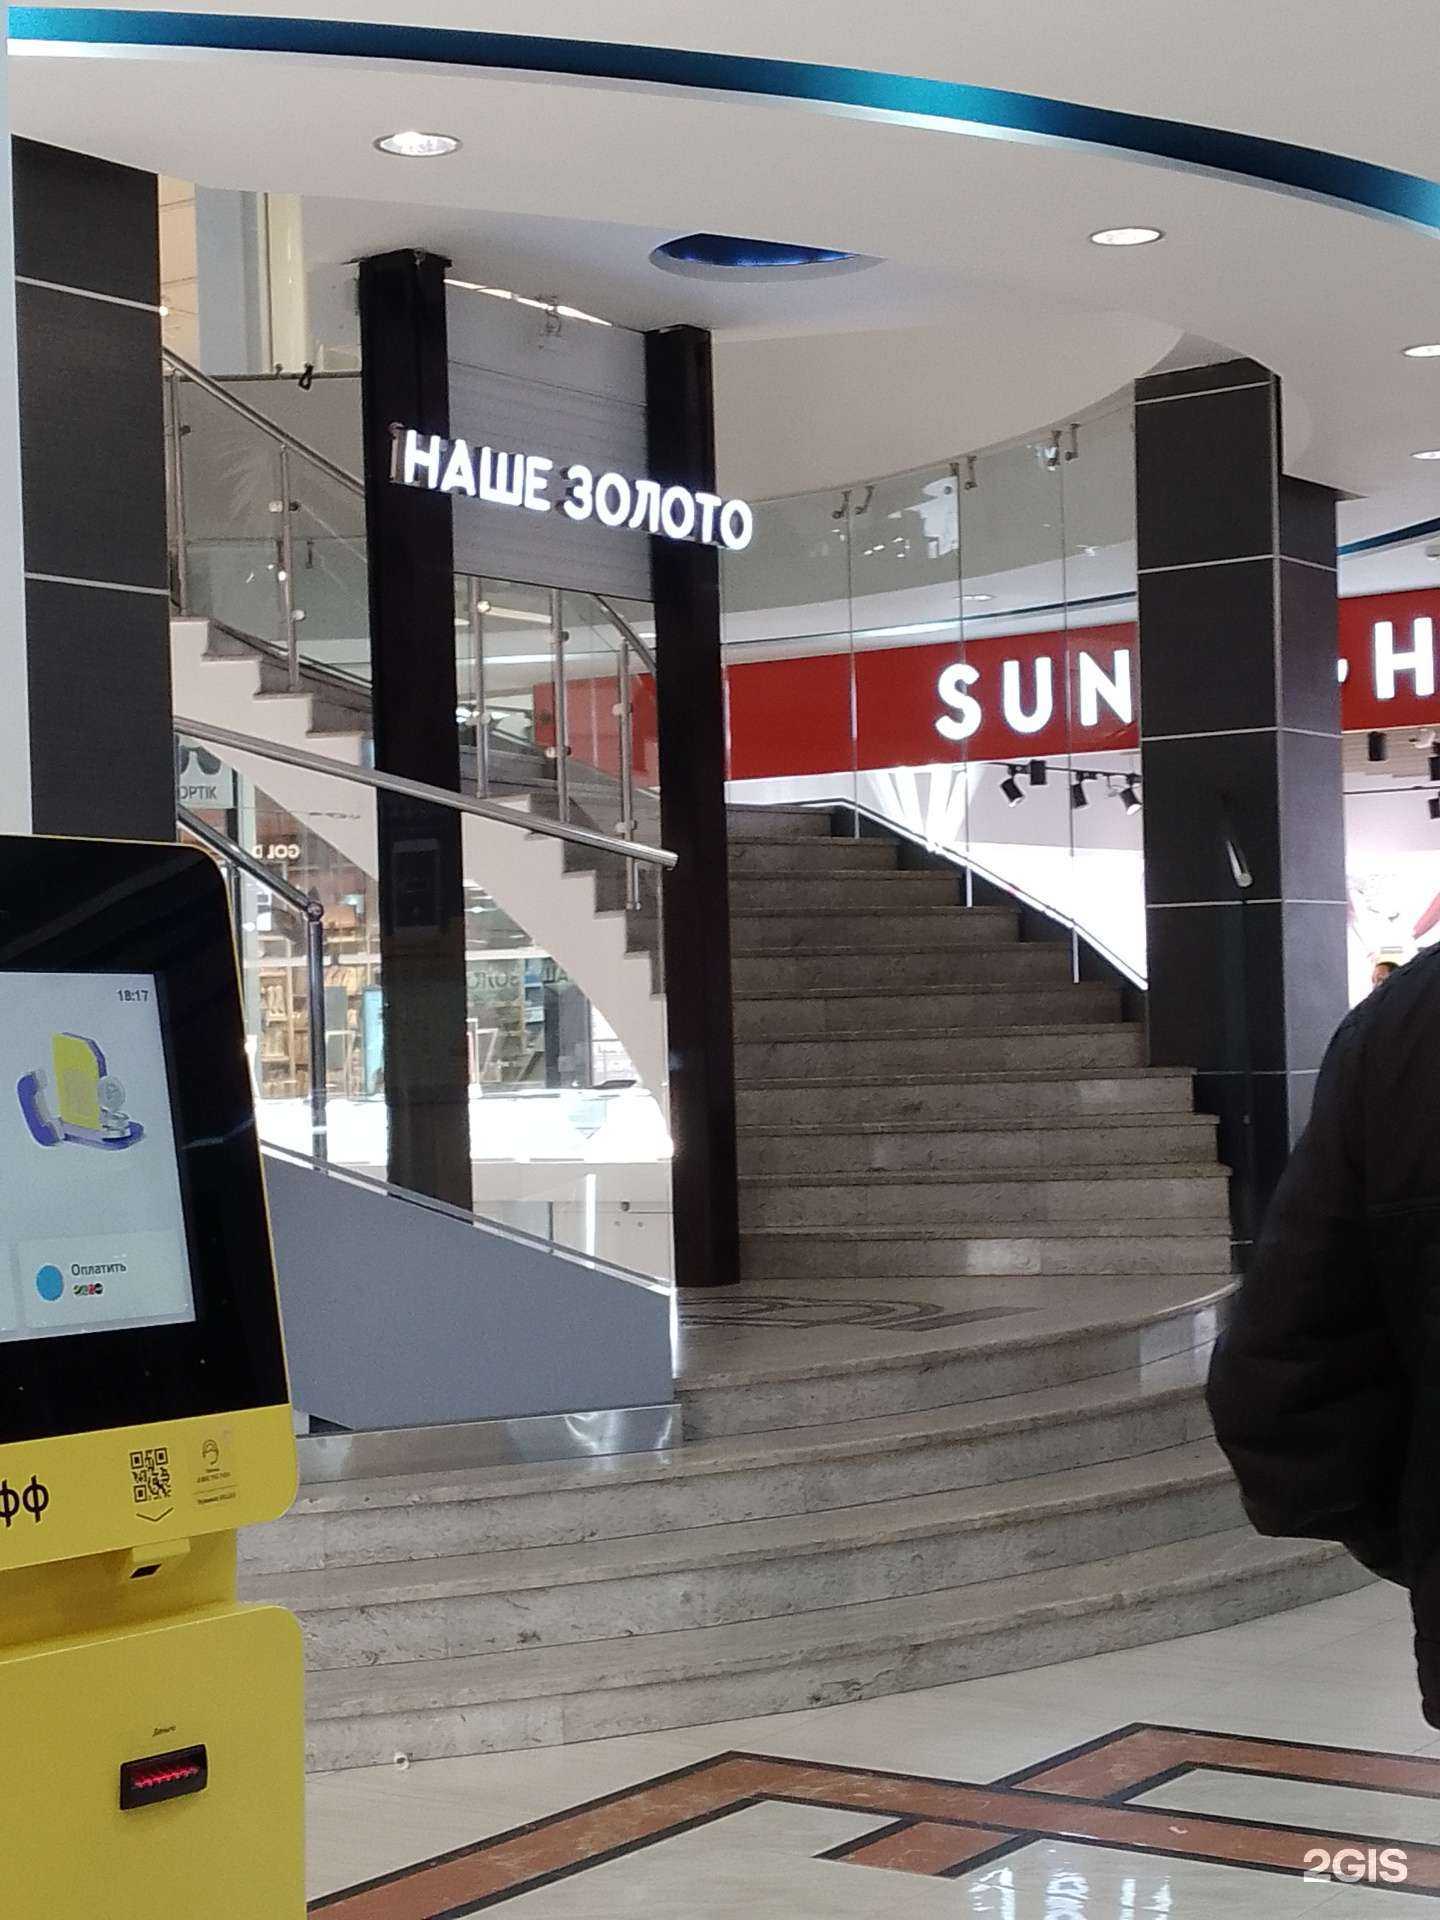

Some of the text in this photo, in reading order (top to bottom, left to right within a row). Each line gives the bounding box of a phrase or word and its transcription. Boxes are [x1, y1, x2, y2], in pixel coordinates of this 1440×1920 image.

[403, 429, 753, 550] НАШЕ ЗОЛОТО
[117, 989, 149, 1002] 18:17
[71, 1262, 127, 1277] Оплатить
